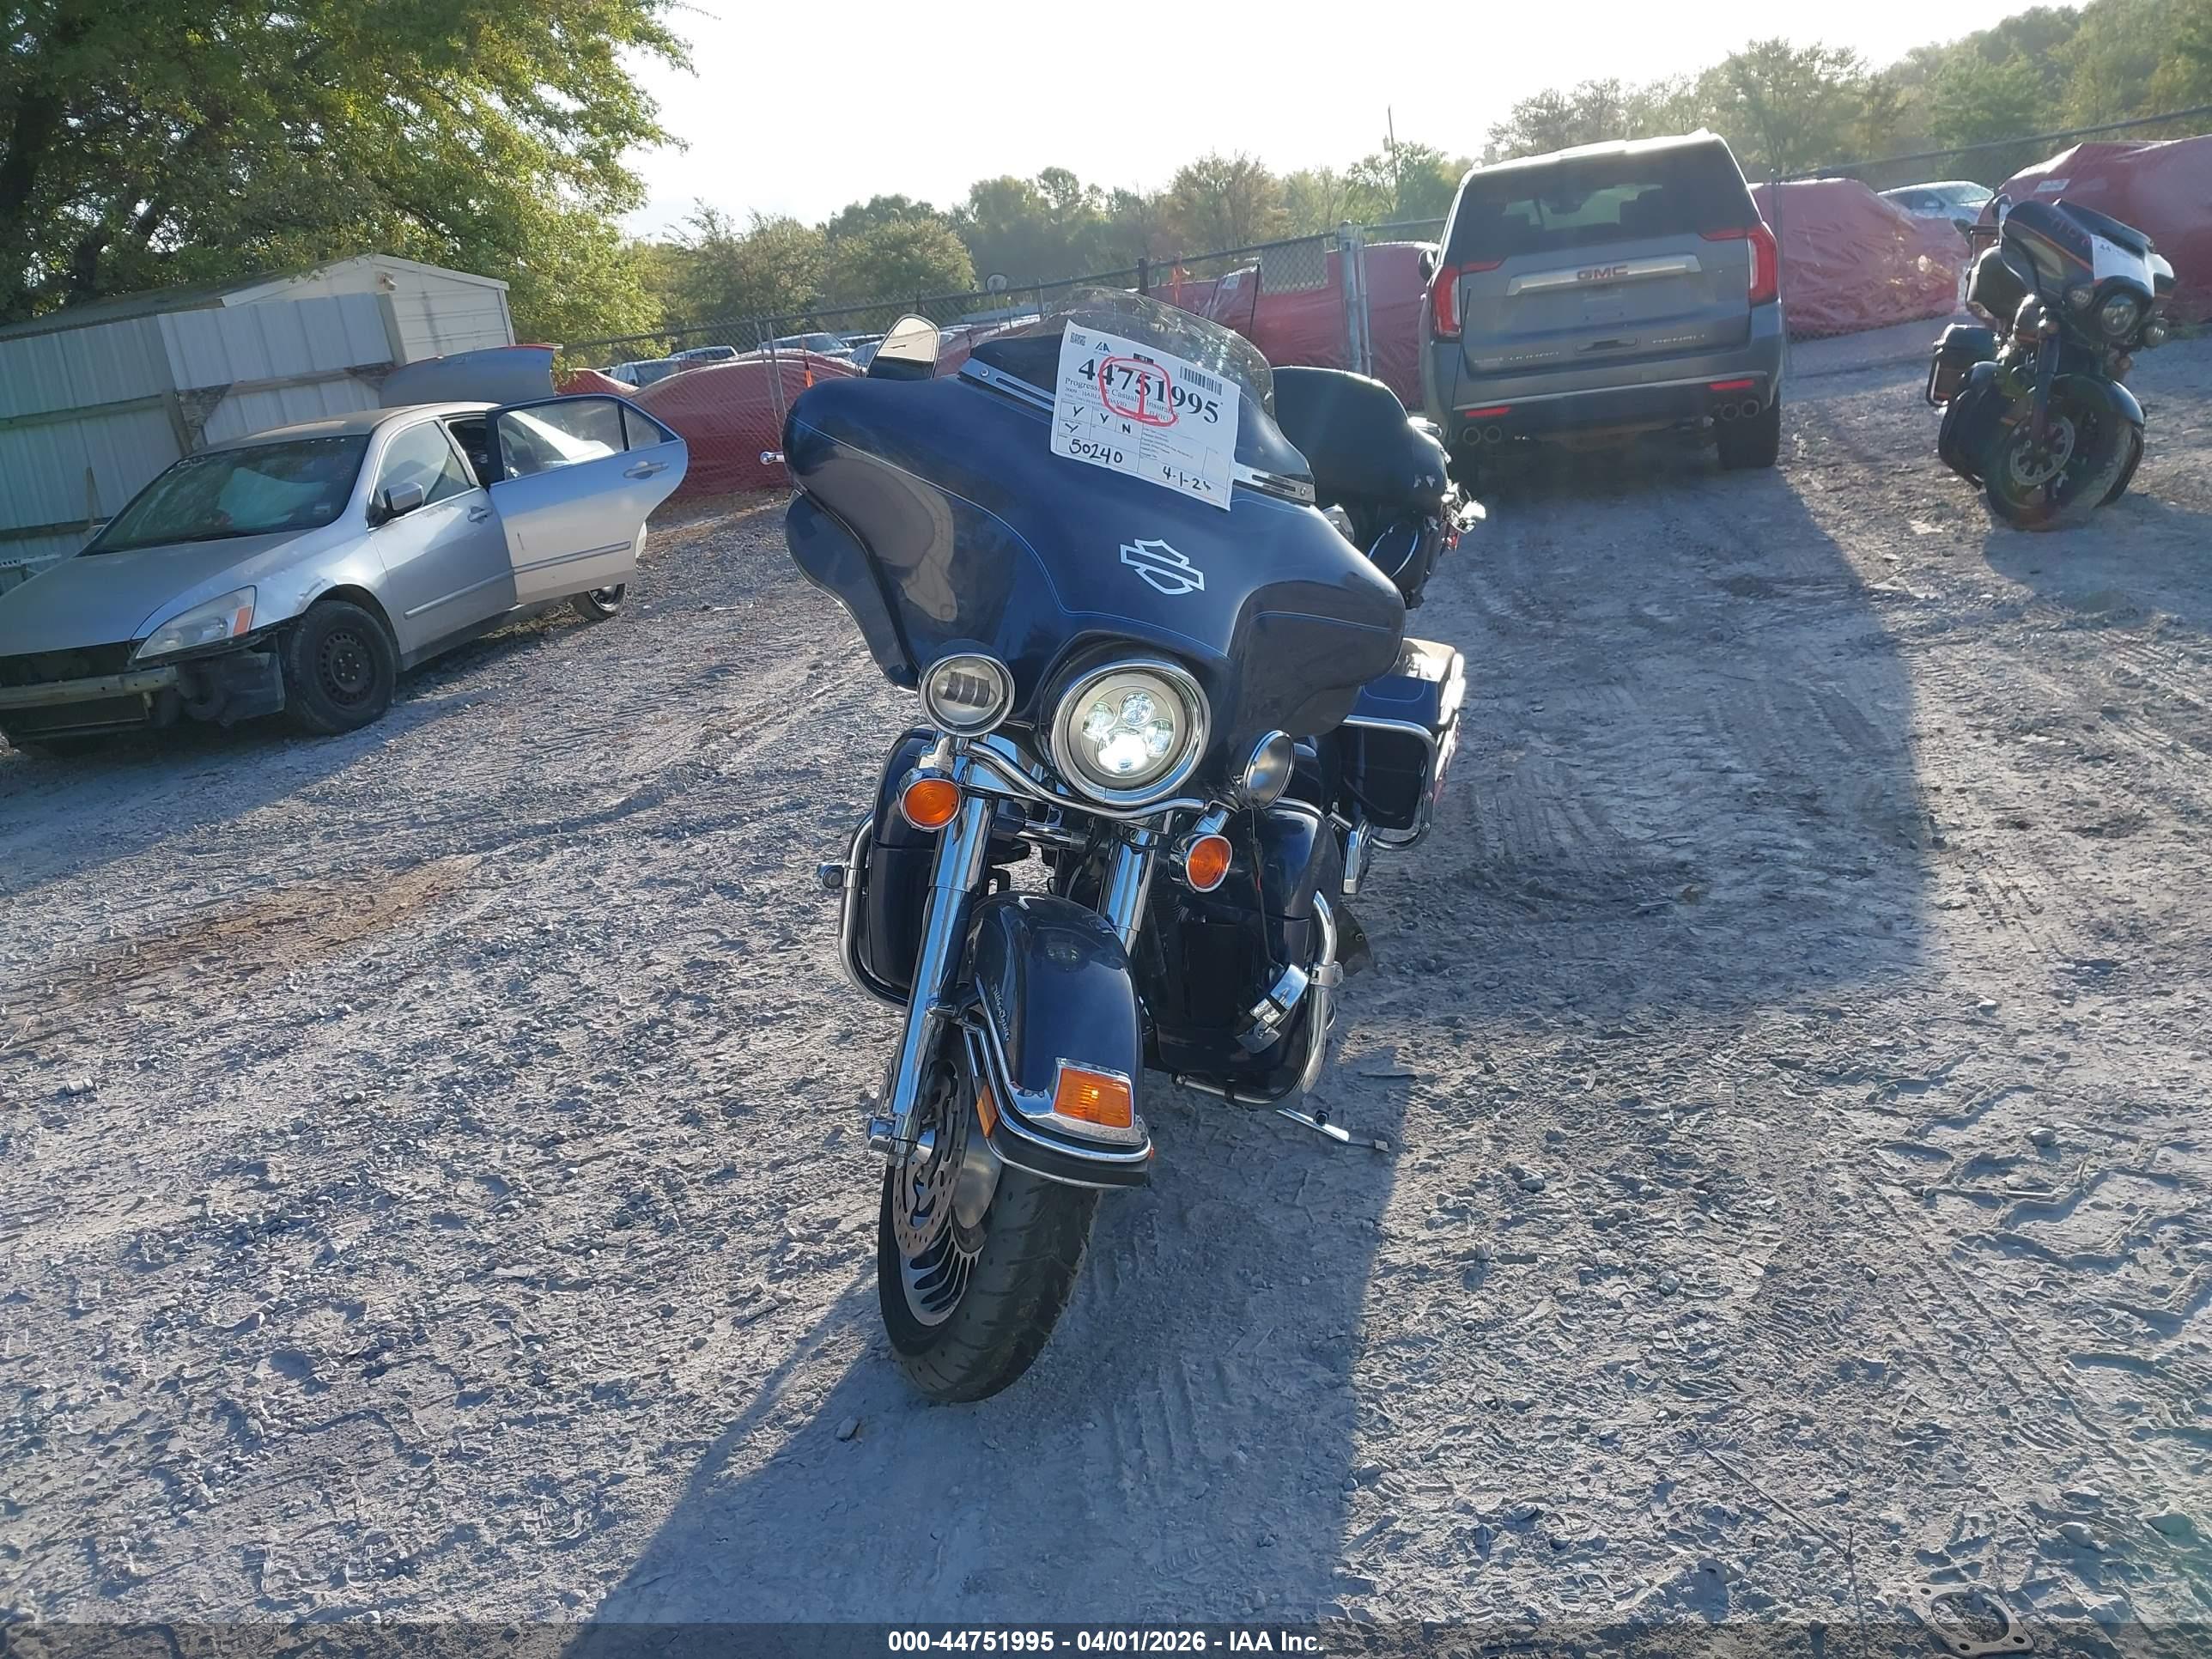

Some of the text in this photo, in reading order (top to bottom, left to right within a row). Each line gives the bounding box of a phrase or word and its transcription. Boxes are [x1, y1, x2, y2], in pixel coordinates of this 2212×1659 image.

[1577, 264, 1629, 280] GMC
[1065, 377, 1109, 394] Progressie
[1111, 389, 1145, 404] Casualt
[1146, 398, 1181, 416] Insurane
[1078, 358, 1219, 424] 44751995
[1073, 405, 1085, 417] Y
[1100, 412, 1109, 424] Y
[1065, 422, 1079, 434] Y
[1121, 423, 1131, 434] N
[1069, 438, 1123, 465] 50240
